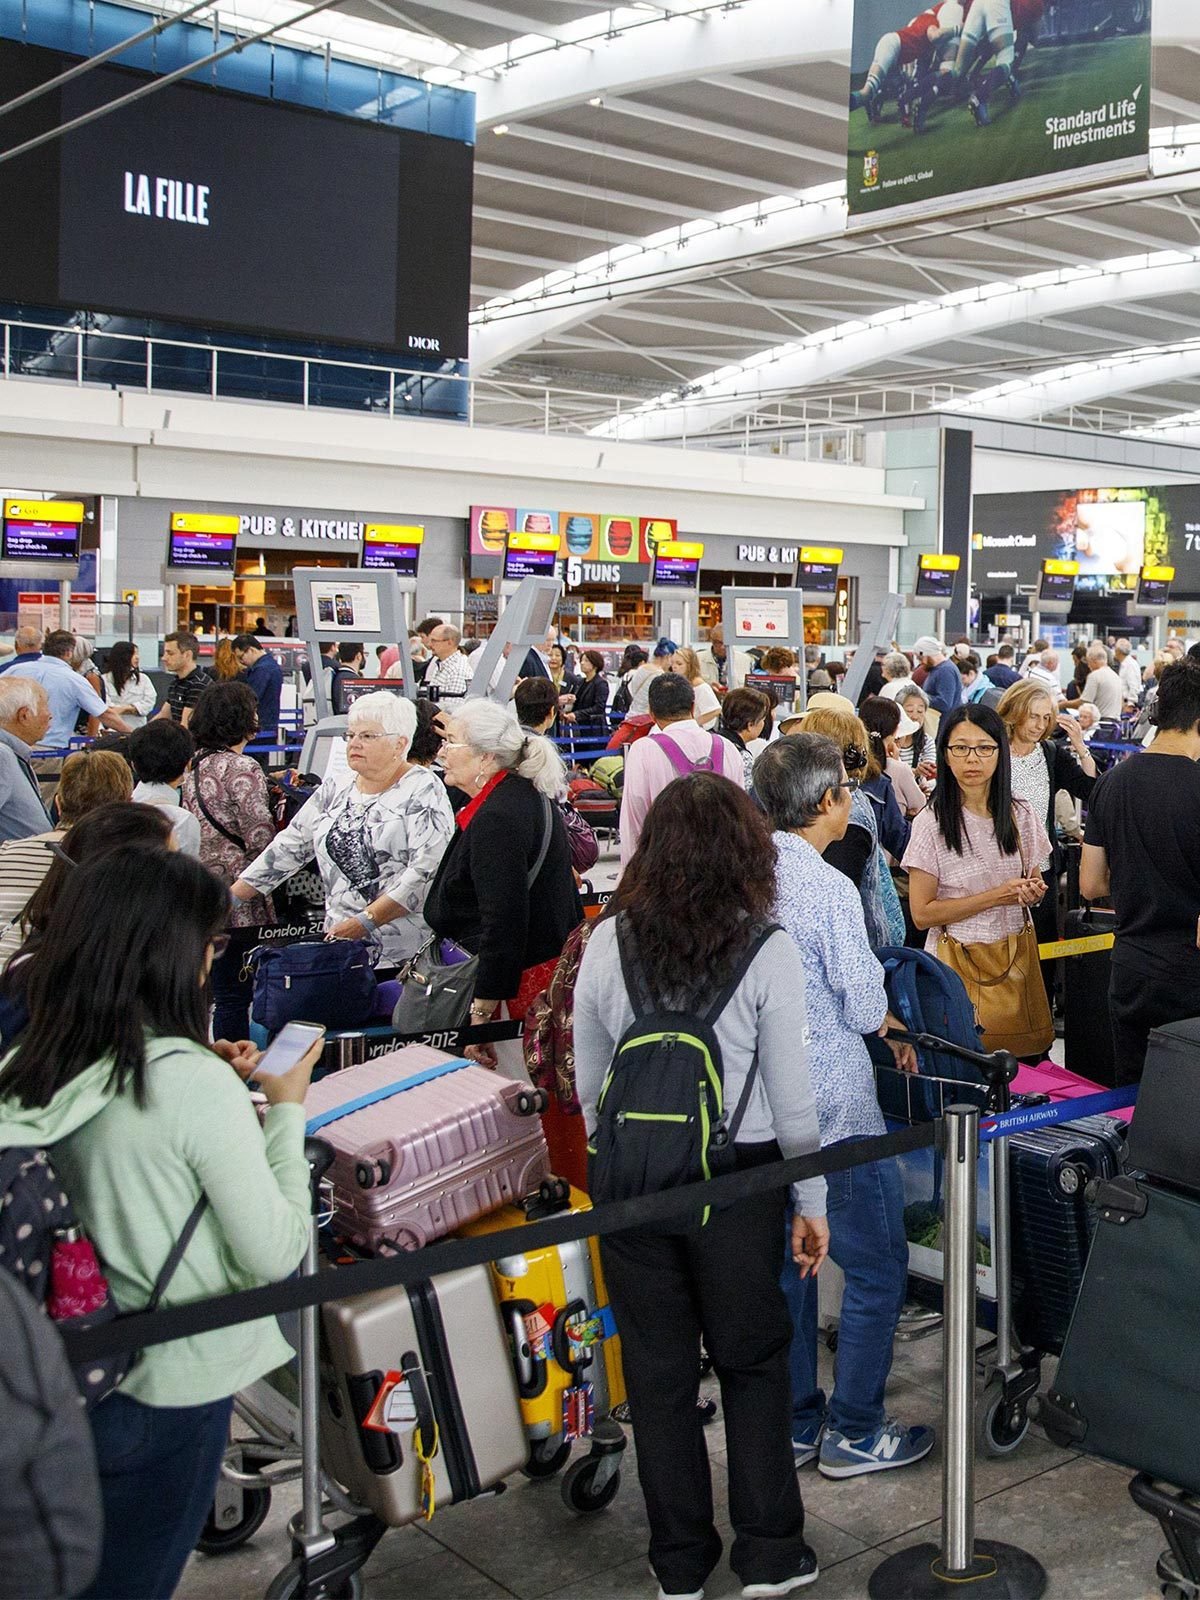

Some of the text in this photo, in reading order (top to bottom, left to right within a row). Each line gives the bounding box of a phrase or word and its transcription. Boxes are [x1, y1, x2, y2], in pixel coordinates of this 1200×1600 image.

[1046, 99, 1136, 135] Standard Life
[1053, 119, 1136, 150] Investments
[124, 171, 210, 226] LA FILLE
[408, 336, 440, 352] DIOR
[239, 515, 276, 536] PUB
[282, 518, 296, 536] &
[738, 545, 765, 562] PUB
[769, 546, 778, 562] &
[1184, 533, 1194, 550] 7
[567, 556, 582, 586] 5
[583, 564, 620, 582] TUNS
[839, 590, 847, 636] PUB
[258, 924, 306, 939] London
[369, 1031, 459, 1058] ndon 2012
[1000, 1108, 1058, 1128] BRITISH AIRWAYS
[872, 1434, 901, 1460] N
